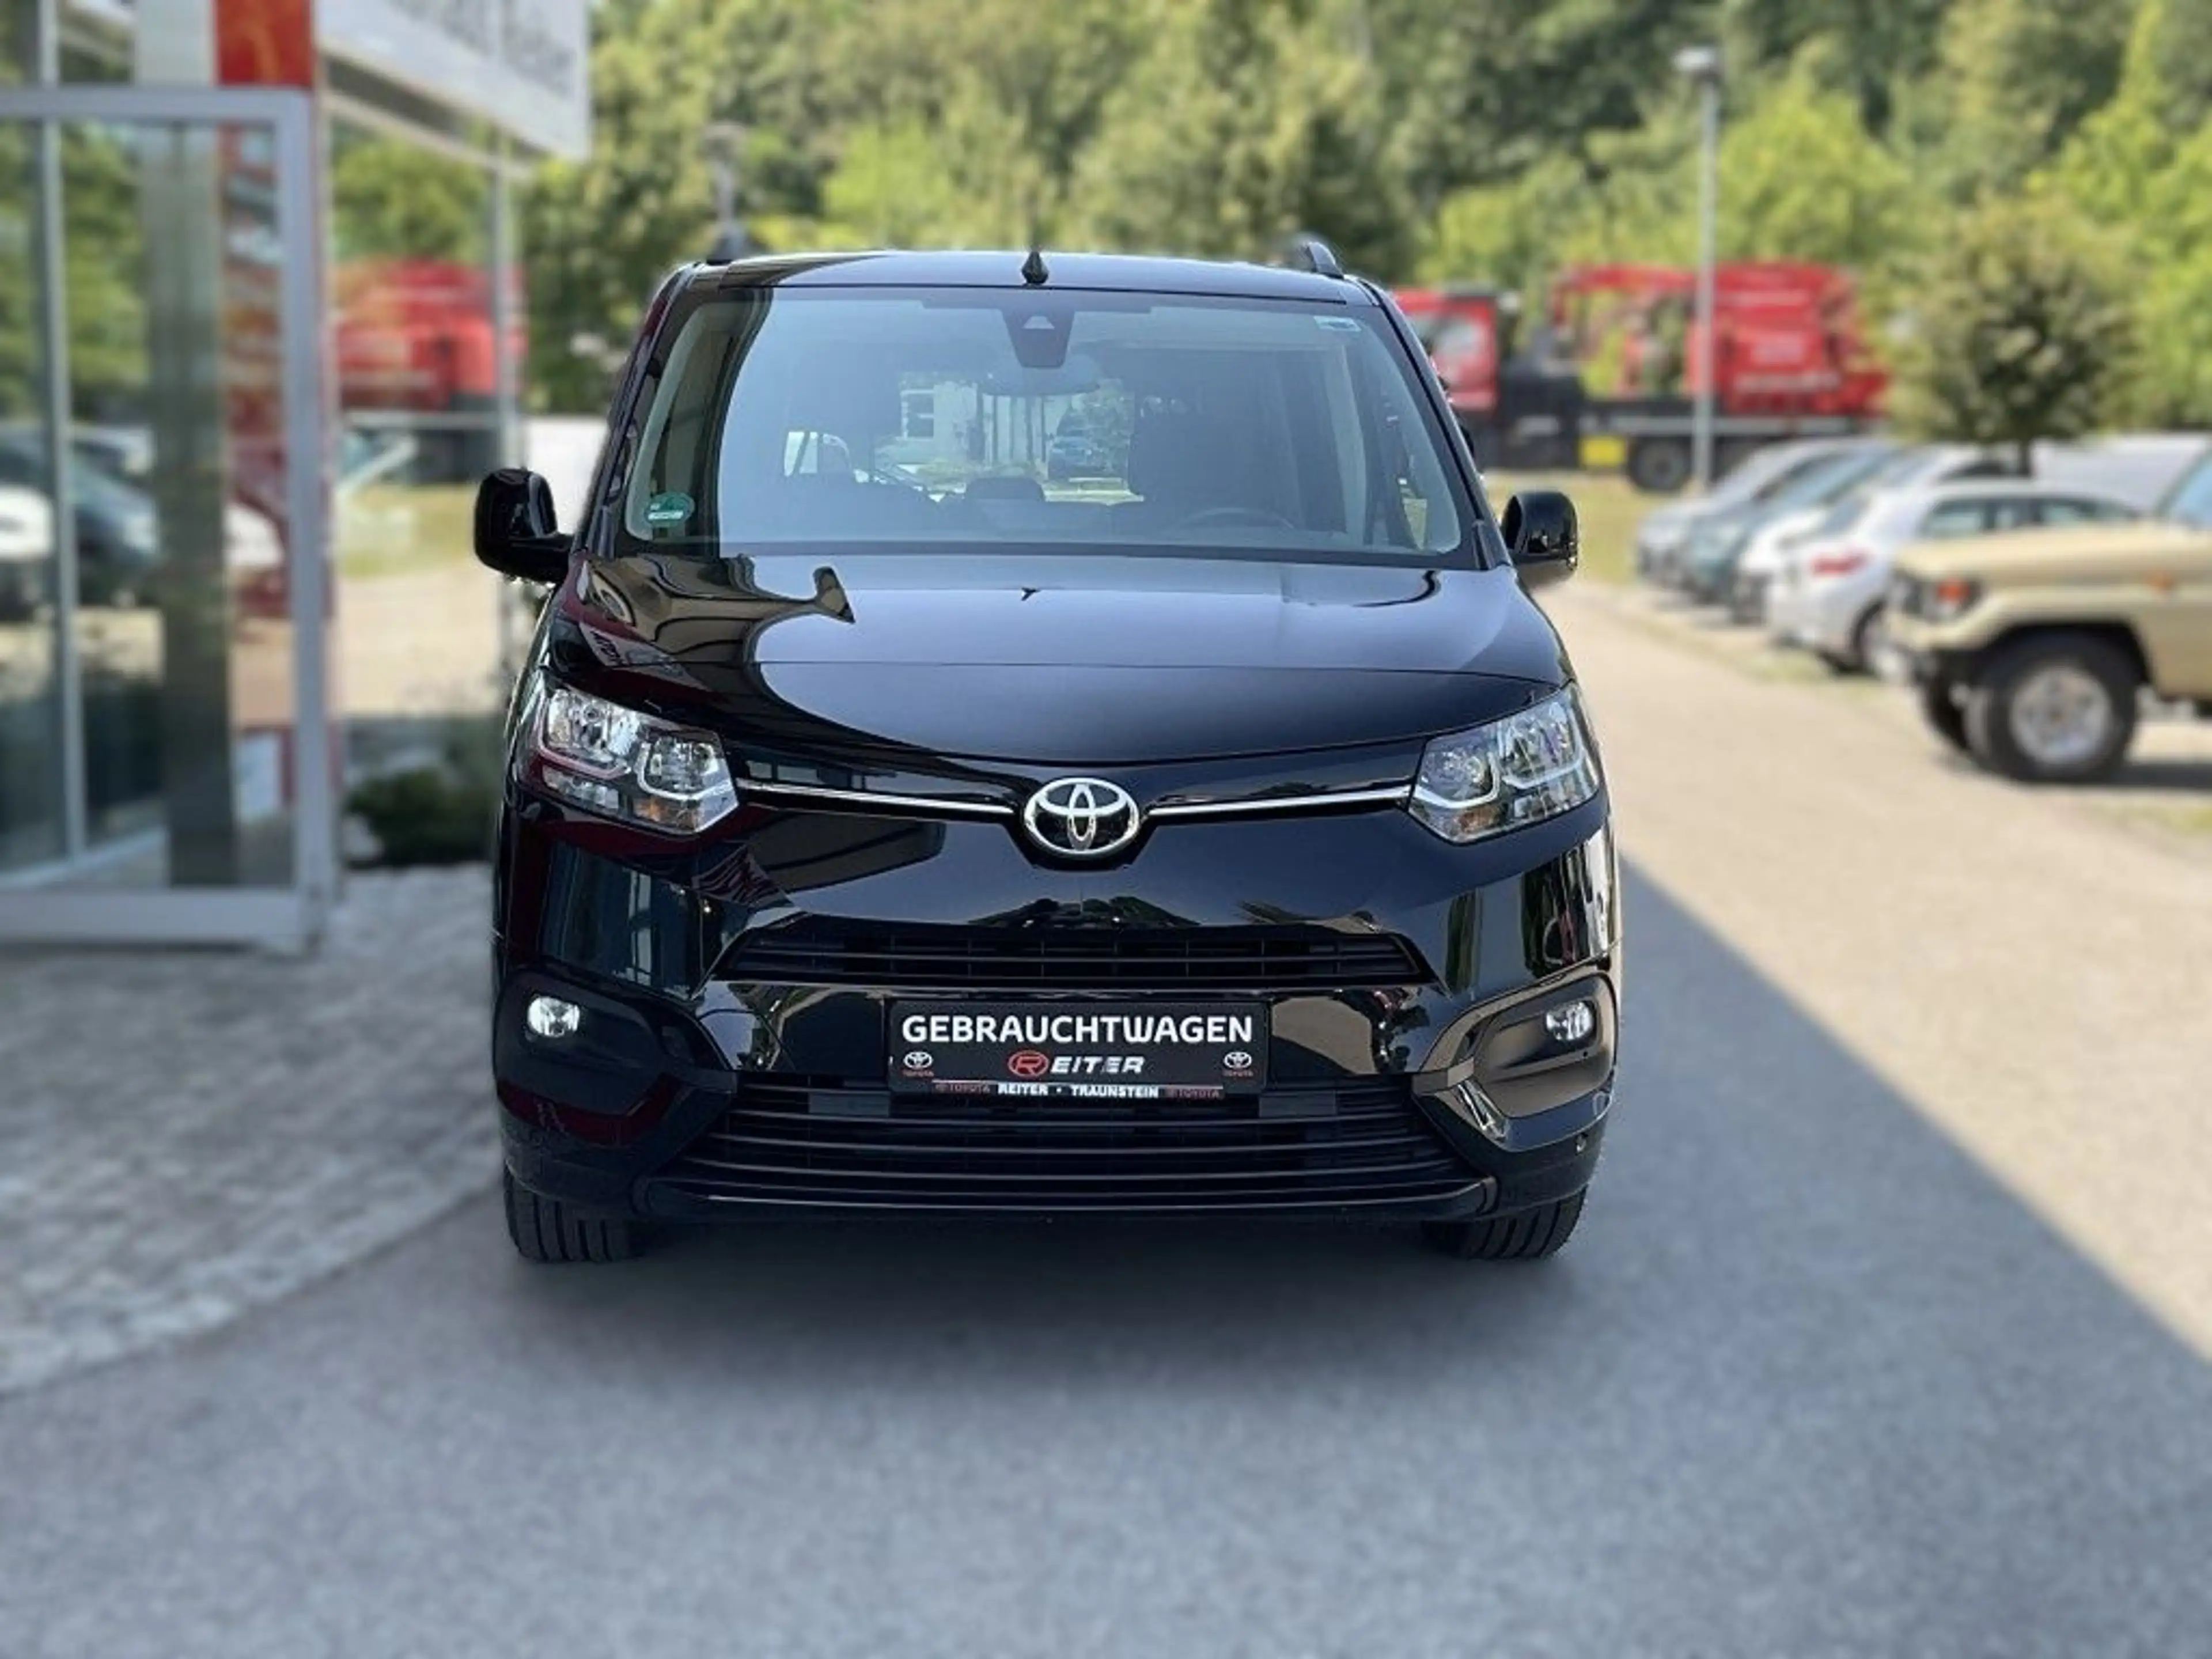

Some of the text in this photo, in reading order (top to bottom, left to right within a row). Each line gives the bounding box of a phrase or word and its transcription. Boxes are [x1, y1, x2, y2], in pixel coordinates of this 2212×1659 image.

[902, 1015, 1252, 1043] GEBRAUCHTWAGEN
[1007, 1050, 1145, 1077] REITER
[998, 1082, 1048, 1096] REITER
[1071, 1084, 1159, 1098] TRAUNSTEIN
